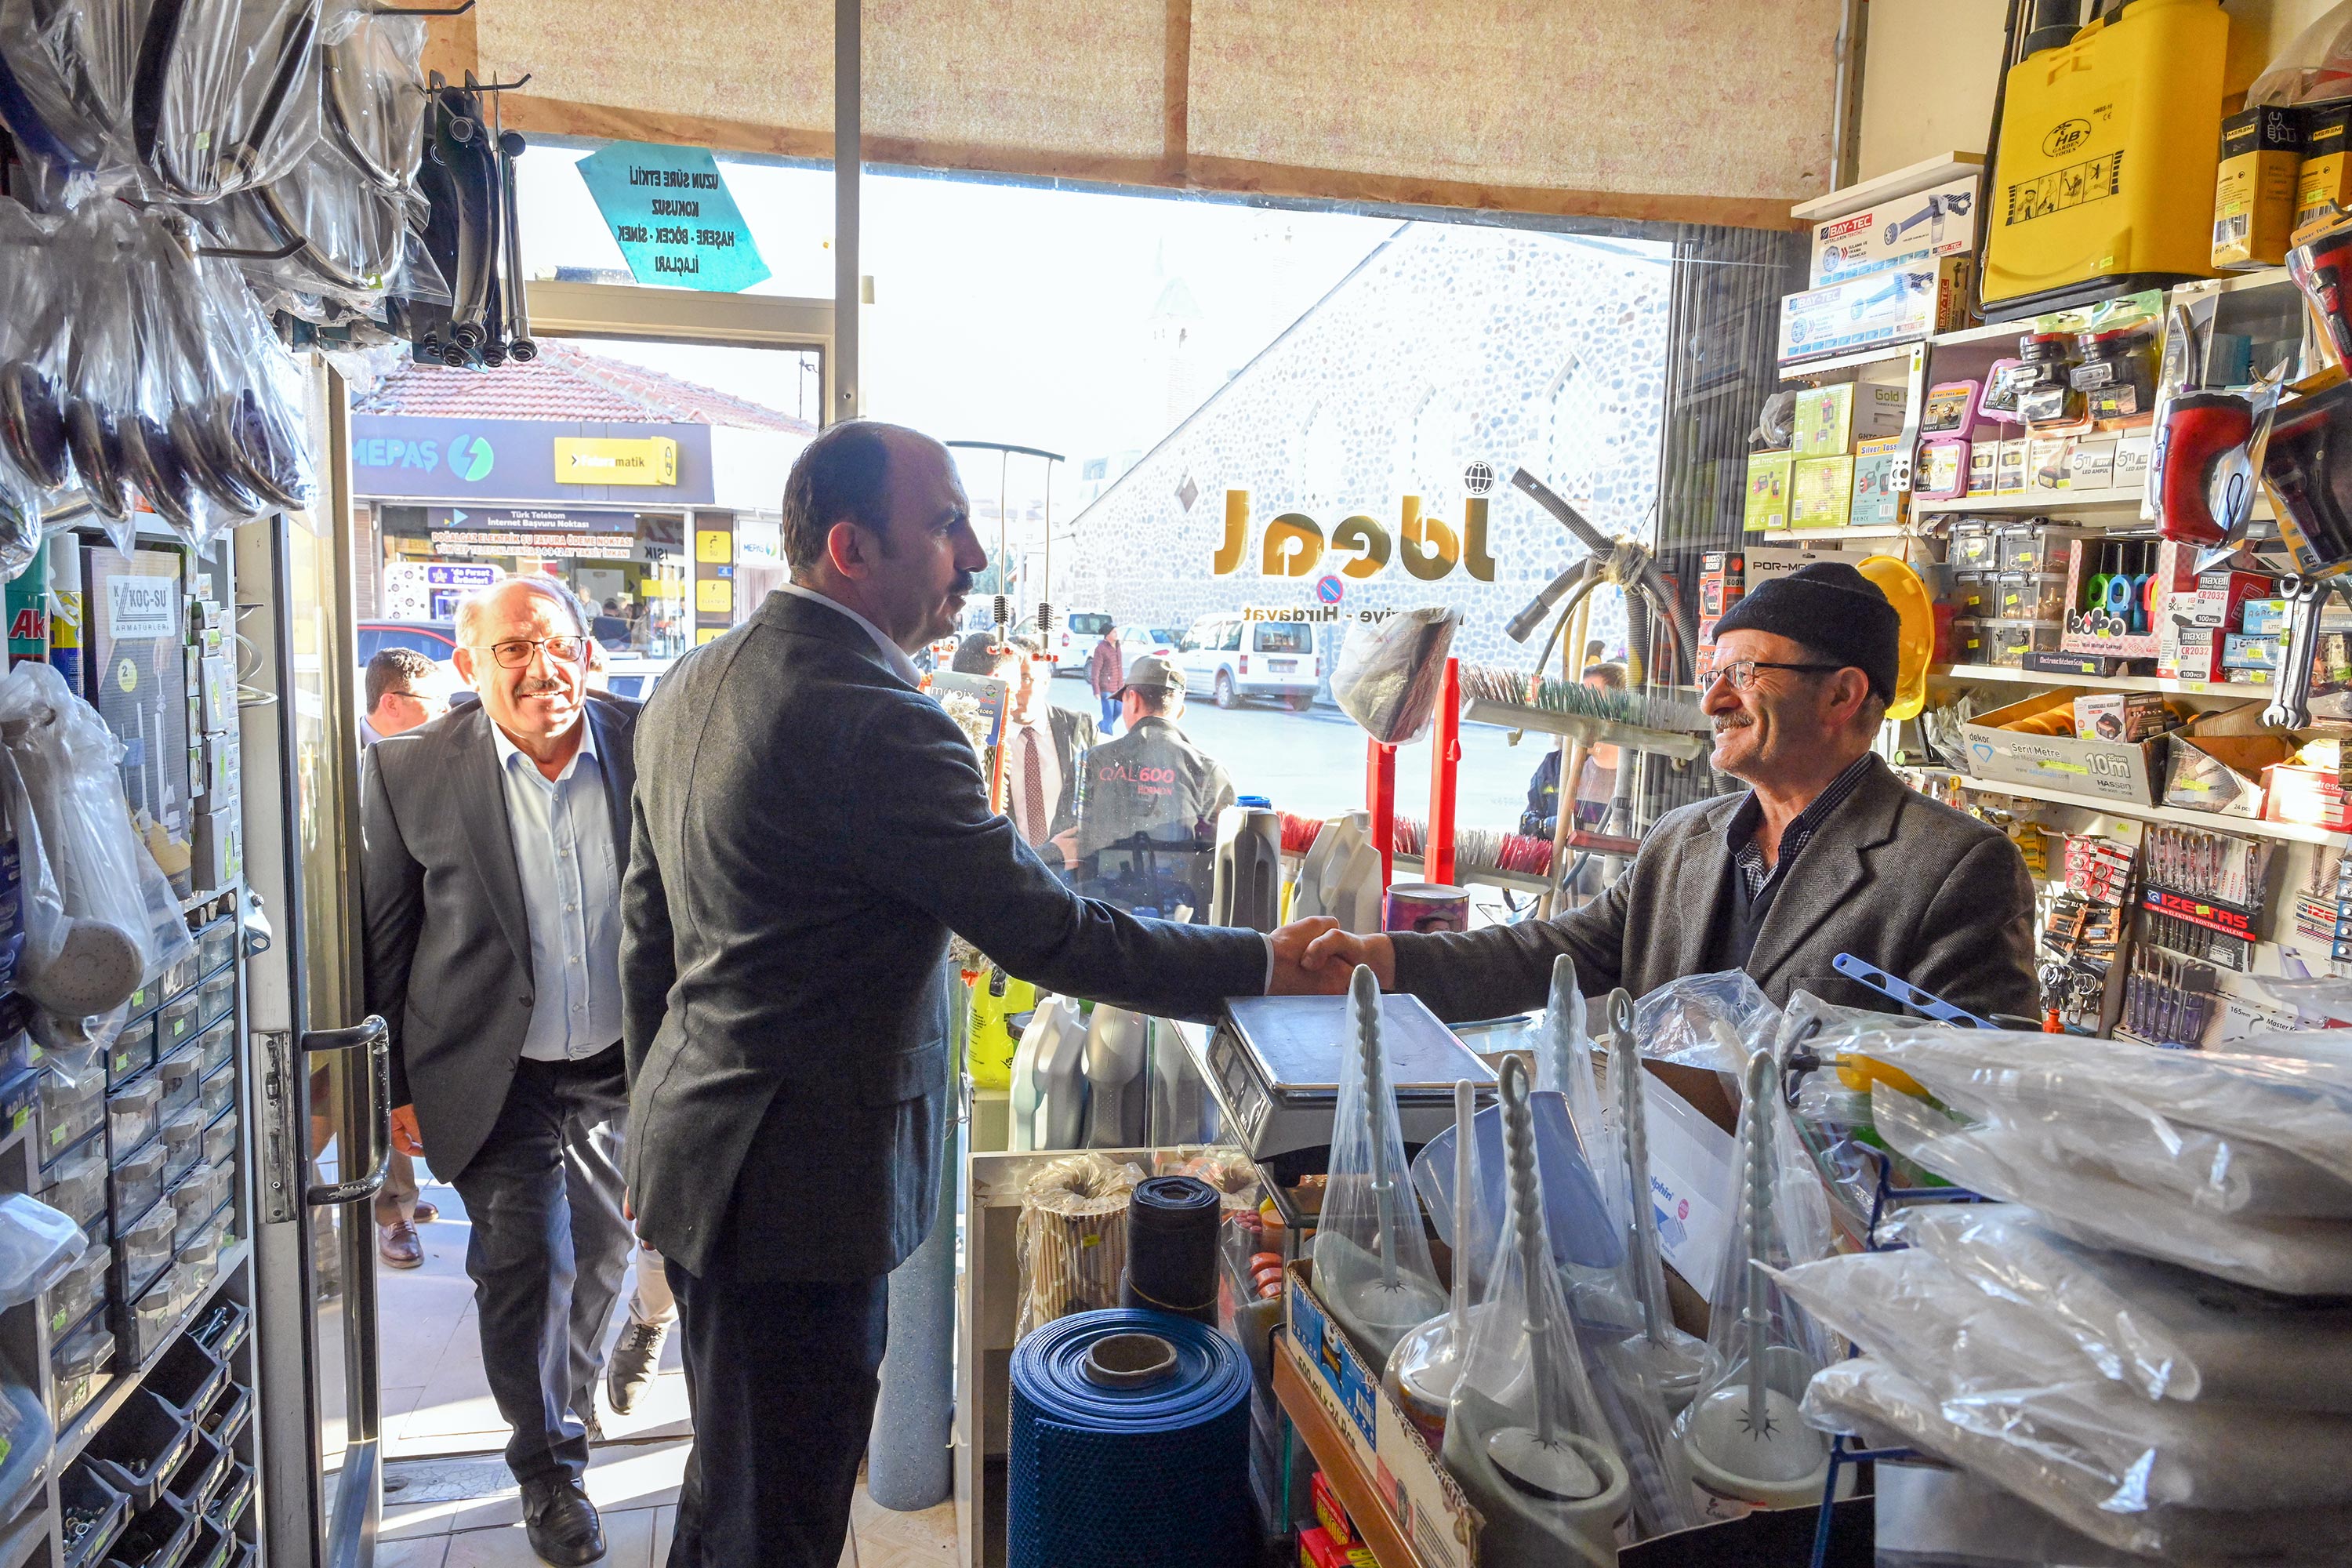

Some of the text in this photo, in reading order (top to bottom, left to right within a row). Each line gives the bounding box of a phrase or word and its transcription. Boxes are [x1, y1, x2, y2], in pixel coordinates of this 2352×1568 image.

[2227, 124, 2254, 138] MESEM
[2314, 126, 2343, 139] MESEM
[2055, 130, 2082, 147] HB
[2052, 140, 2080, 154] GARDEN
[2054, 147, 2077, 158] TOOLS
[1829, 213, 1872, 238] BAY-TEC
[1937, 241, 1962, 253] BAY-TEC
[1798, 289, 1841, 309] BAY-TEC
[1939, 281, 1949, 327] BAY-TEC
[1875, 388, 1900, 402] Gold
[1860, 443, 1898, 455] Silver Toss
[510, 510, 566, 520] Türk Telekom
[487, 517, 590, 528] İnternet Başvuru Noktası
[431, 531, 477, 543] DOĞALGAZ
[478, 532, 520, 544] ELEKTRİK
[534, 534, 567, 546] FATURA
[567, 534, 597, 546] ÖDEME
[597, 535, 633, 548] NOKTASI
[2200, 575, 2229, 586] maxell
[130, 589, 167, 613] KOÇ-SU
[2198, 590, 2226, 601] CR2032
[2182, 631, 2212, 641] maxell
[2180, 646, 2209, 656] CR2032
[1969, 731, 1991, 743] dekor
[2034, 746, 2061, 758] Metre
[2107, 753, 2127, 763] 25mm
[1139, 767, 1176, 784] 600
[2161, 893, 2249, 930] IZETAS
[2169, 910, 2195, 924] ELEKTRİK
[2195, 916, 2222, 931] KONTROL
[2221, 925, 2244, 938] KALEMİ
[2230, 1005, 2251, 1019] 165mm
[2266, 1018, 2288, 1031] Master
